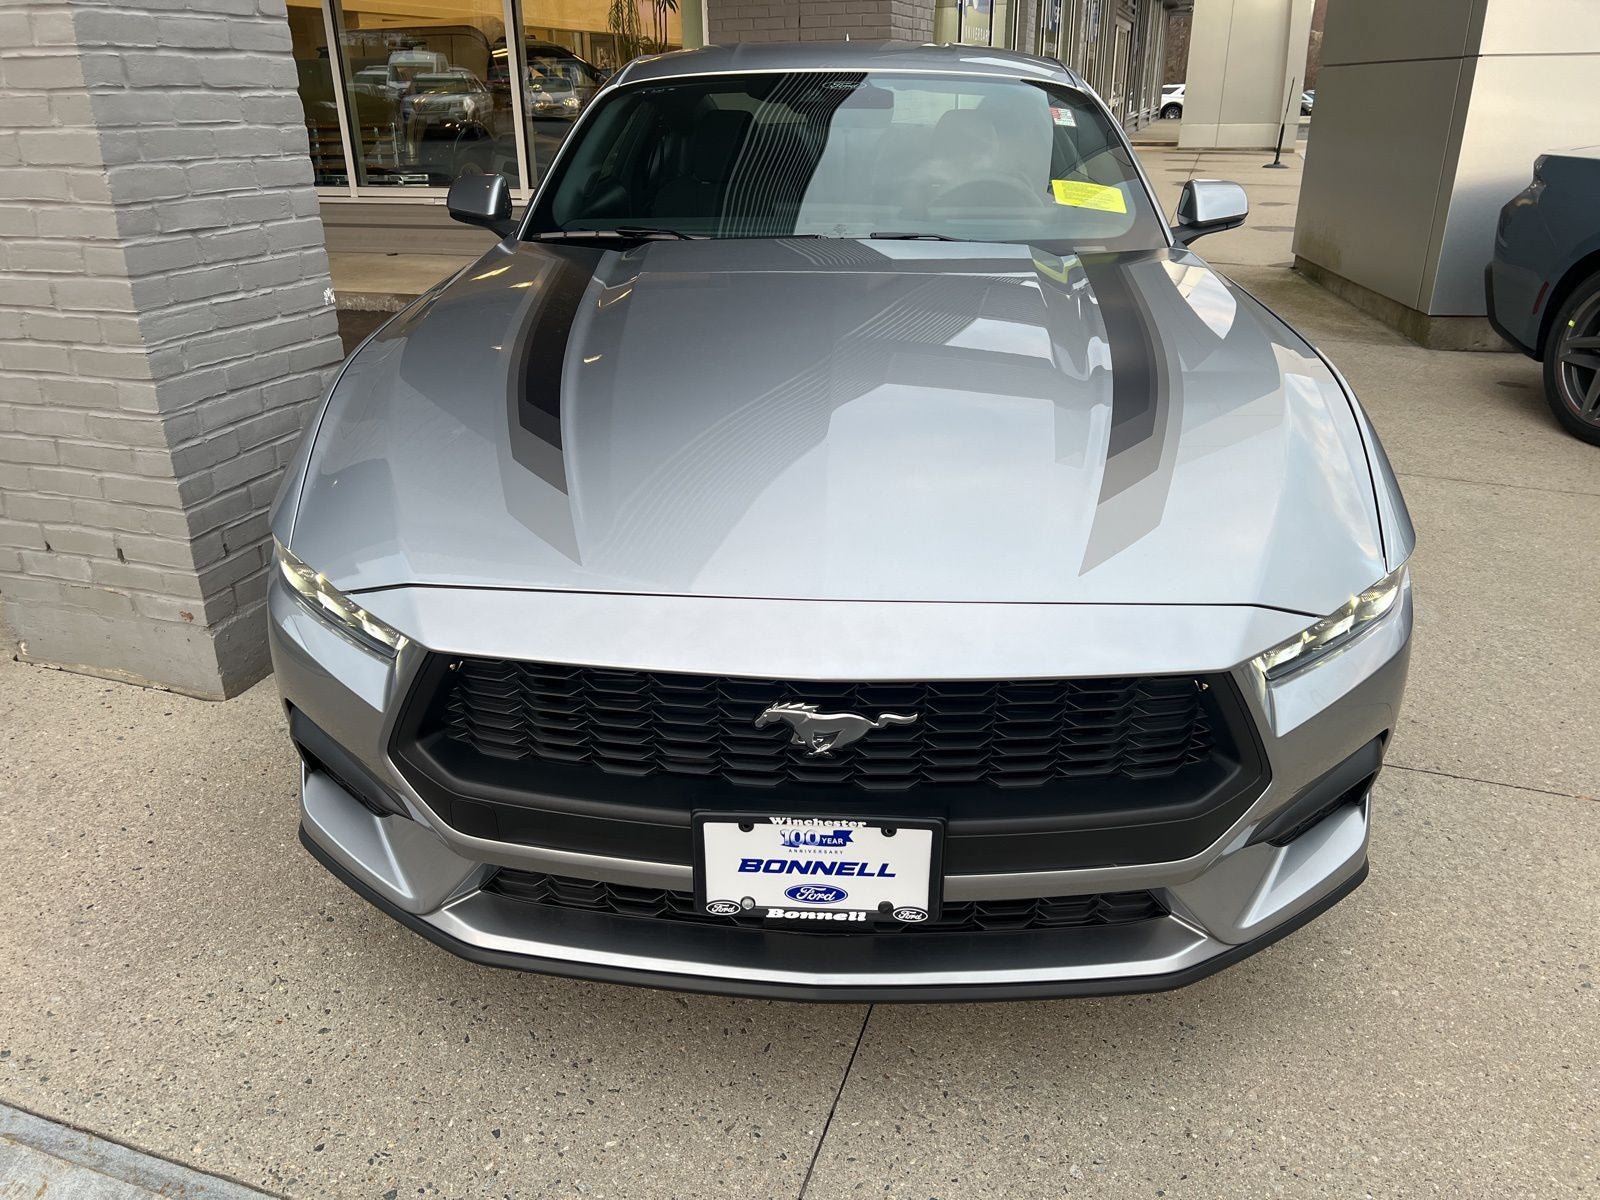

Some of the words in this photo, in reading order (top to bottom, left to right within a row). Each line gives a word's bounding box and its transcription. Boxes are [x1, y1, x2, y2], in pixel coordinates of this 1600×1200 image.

[769, 817, 867, 829] Winchester
[780, 829, 819, 846] 100
[821, 837, 844, 845] YEAR
[738, 858, 896, 877] BONNELL
[796, 887, 836, 901] Ford
[711, 903, 735, 913] Ford
[766, 908, 867, 921] Bonnell
[898, 910, 922, 920] Ford
